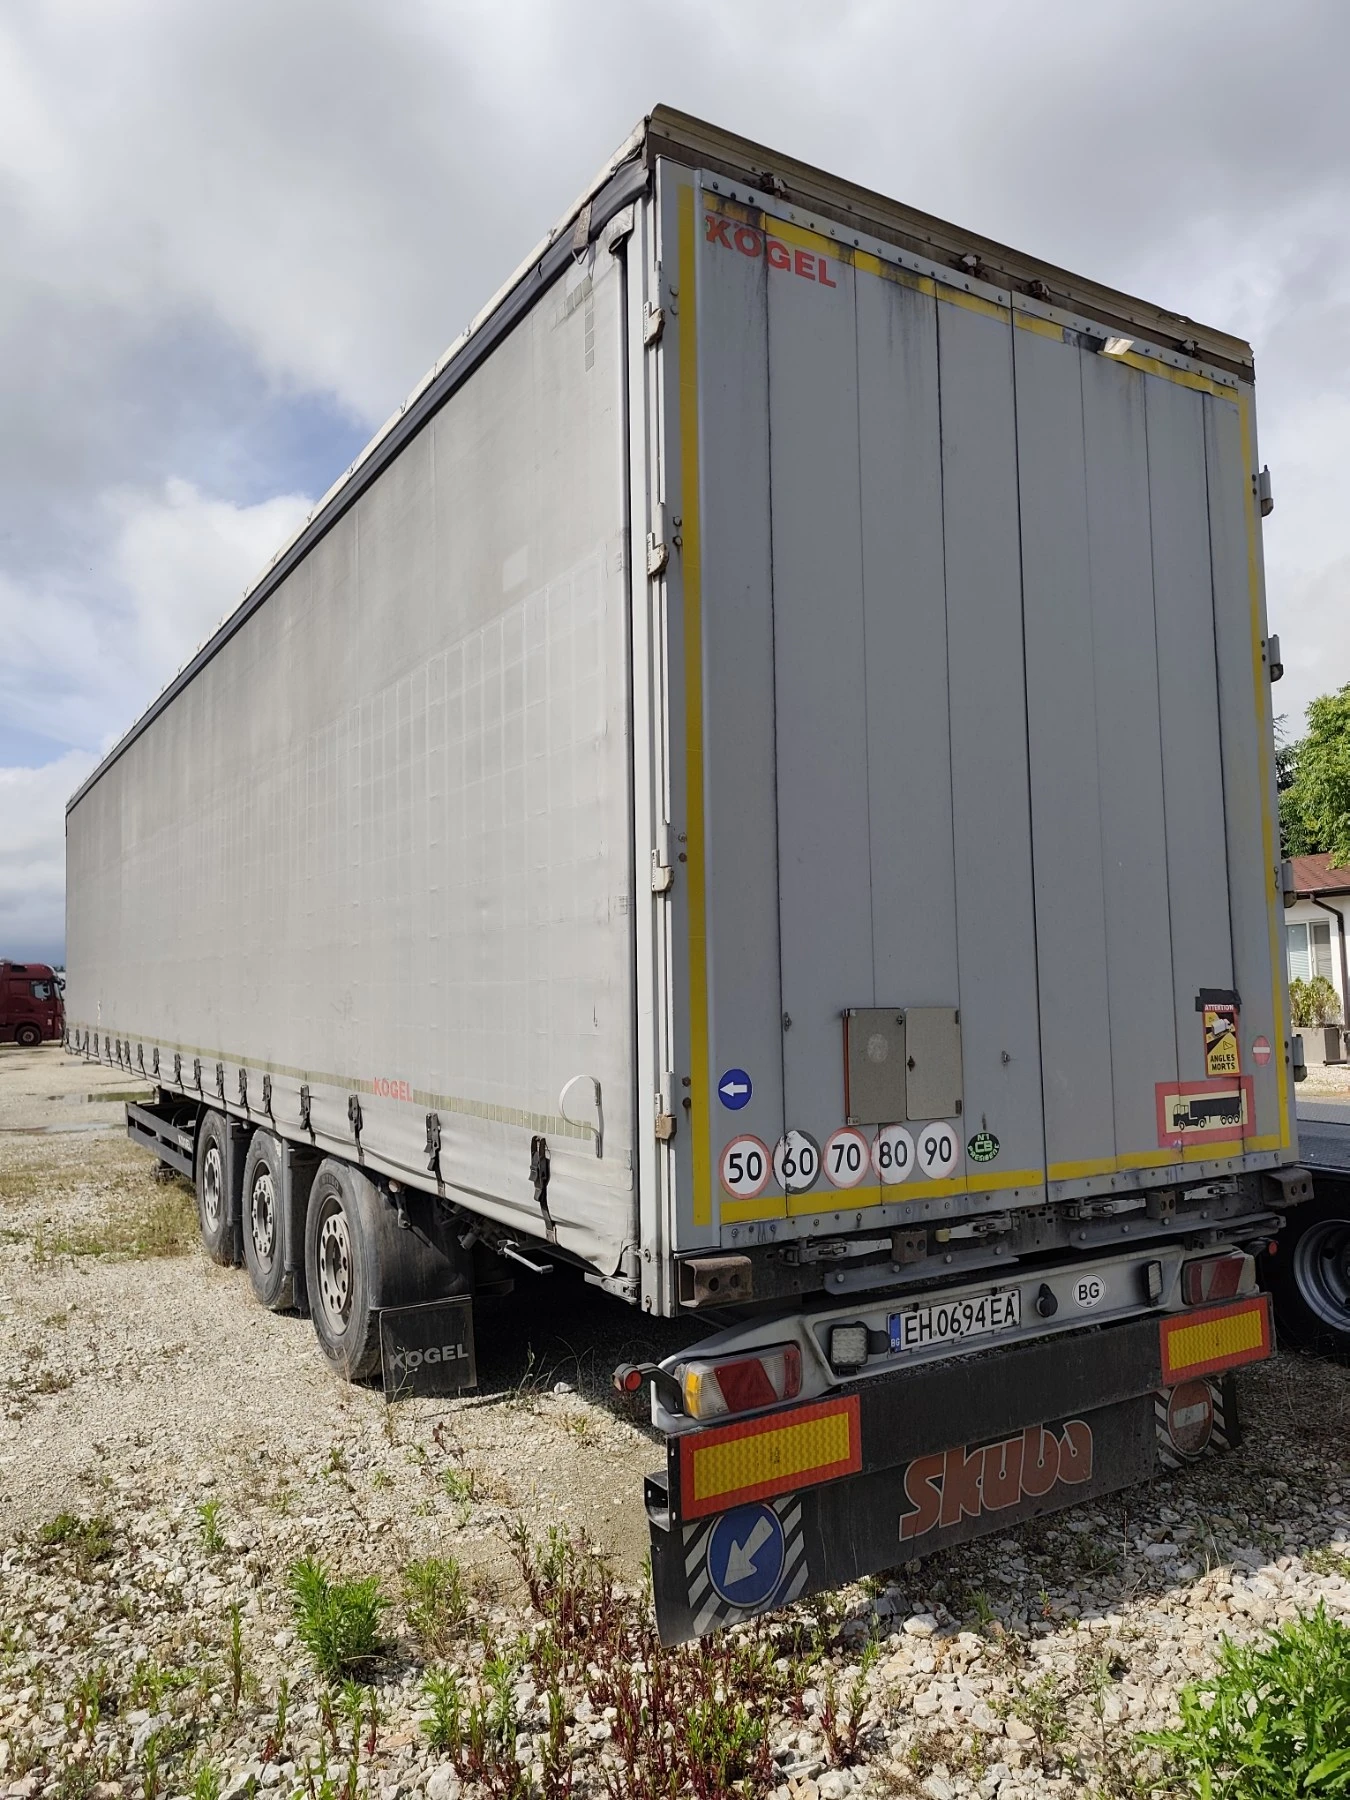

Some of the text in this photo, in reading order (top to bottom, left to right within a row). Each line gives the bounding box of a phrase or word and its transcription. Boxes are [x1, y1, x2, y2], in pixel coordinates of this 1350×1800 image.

[1210, 1053, 1235, 1062] ANGLES
[1211, 1062, 1235, 1070] MORTS
[832, 1143, 861, 1173] 70
[878, 1140, 908, 1168] 80
[924, 1136, 952, 1166] 90
[974, 1140, 993, 1153] CB
[728, 1151, 763, 1184] 50
[781, 1147, 814, 1178] 60
[1078, 1282, 1100, 1301] BG
[891, 1338, 900, 1347] BG
